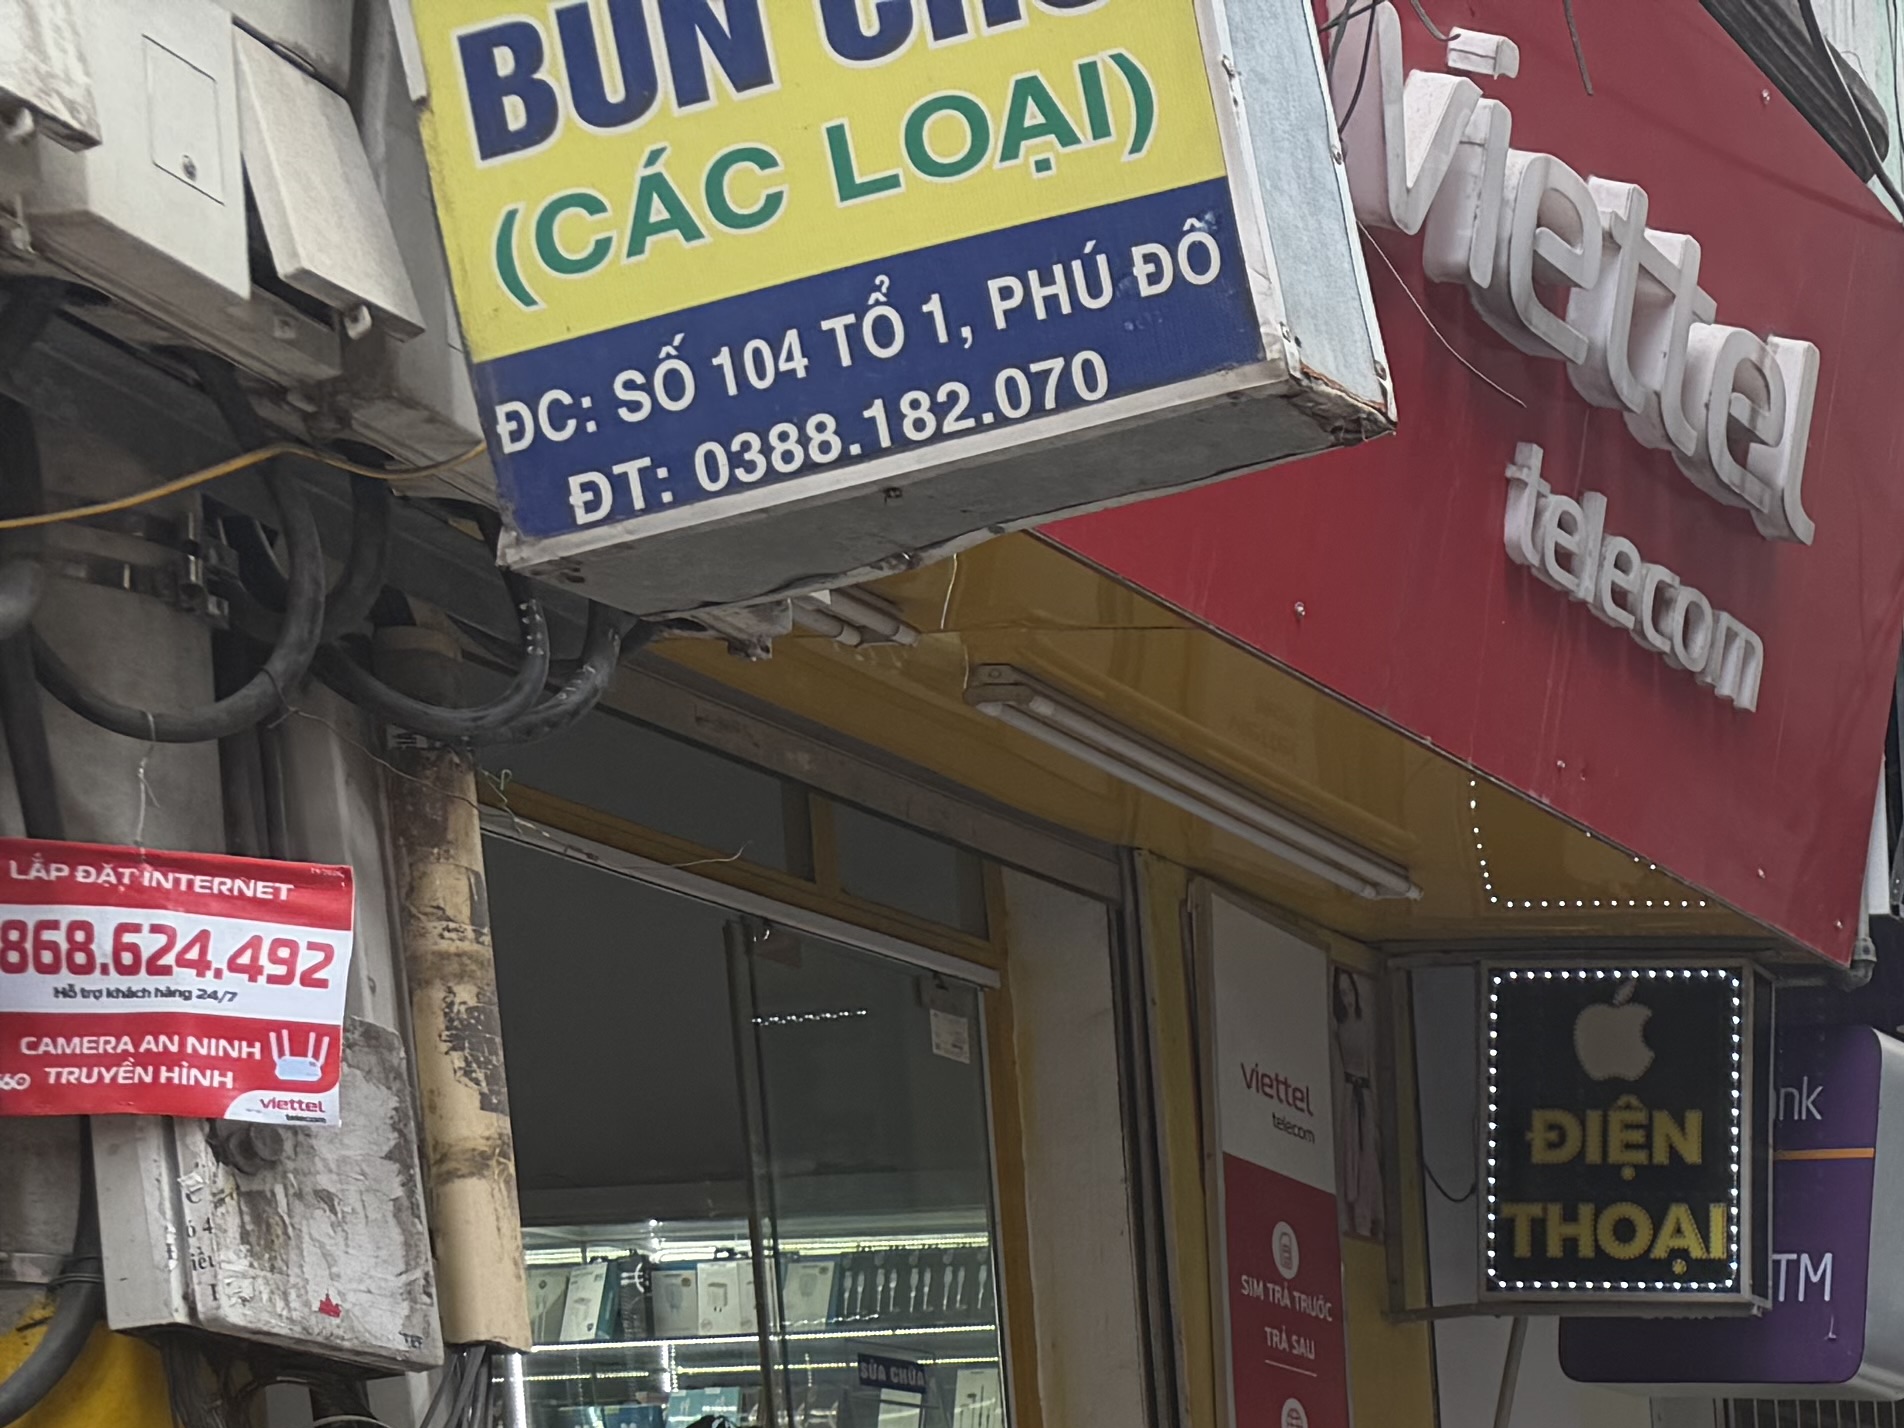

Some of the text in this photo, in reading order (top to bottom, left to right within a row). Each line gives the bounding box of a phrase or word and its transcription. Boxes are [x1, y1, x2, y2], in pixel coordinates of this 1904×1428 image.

[494, 51, 1157, 307] (CÁC LOẠI)
[495, 219, 1222, 454] ĐC: SỐ 104 TỔ 1, PHÚ ĐÔ
[570, 349, 1109, 525] ĐT: 0388.182.070
[1505, 442, 1763, 712] telecom
[9, 854, 70, 881] LẮP
[75, 866, 137, 887] ĐẶT
[142, 869, 294, 900] INTERNET
[106, 987, 152, 1000] khách
[155, 987, 193, 1003] hàng
[196, 988, 238, 1004] 24/7
[19, 1035, 261, 1060] CAMERA AN NINH
[0, 1057, 234, 1090] 60 TRUYỀN HÌNH
[1240, 1062, 1313, 1117] viettel
[260, 1098, 325, 1113] viettel
[1272, 1112, 1315, 1144] telecom
[1527, 1094, 1702, 1181] ĐIỆN
[1500, 1202, 1728, 1275] THOẠI
[1241, 1274, 1264, 1299] SIM
[1267, 1280, 1291, 1309] TRẢ
[1773, 1252, 1832, 1303] TM
[1264, 1324, 1316, 1360] TRẢ SAU
